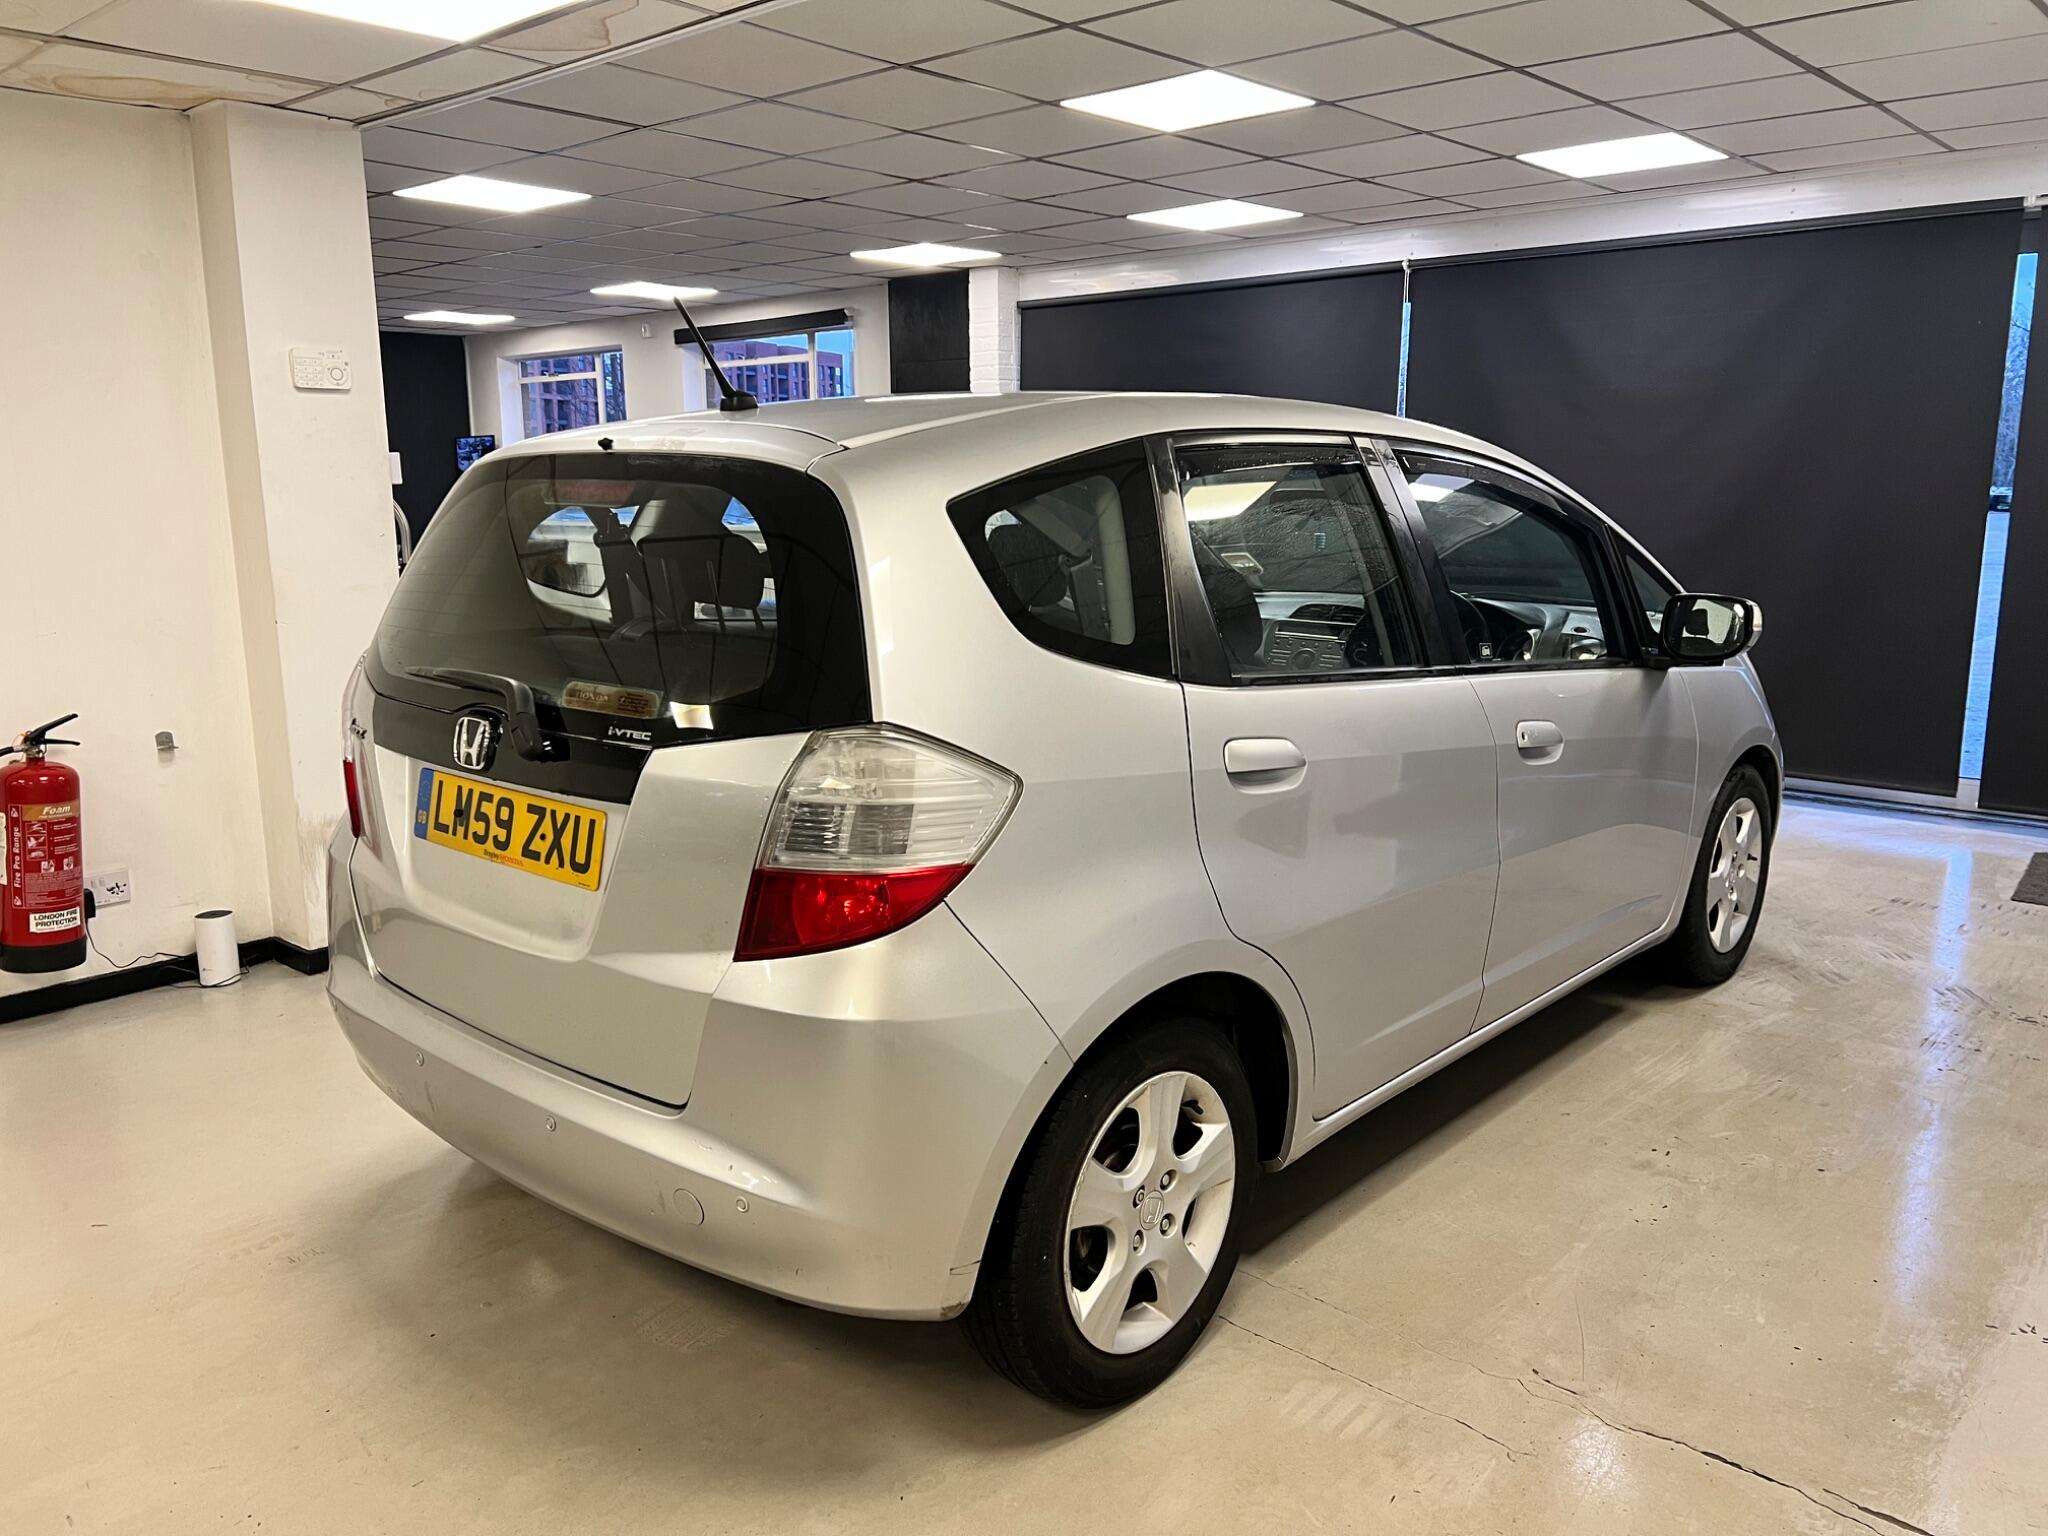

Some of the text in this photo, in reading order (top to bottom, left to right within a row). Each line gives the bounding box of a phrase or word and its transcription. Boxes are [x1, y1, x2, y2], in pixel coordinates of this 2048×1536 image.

[43, 805, 71, 815] Foam
[433, 780, 597, 875] LM59 ZXU
[13, 826, 21, 853] Range
[13, 855, 21, 870] Pro
[34, 913, 65, 921] LONDON
[35, 916, 77, 927] PROTECTION
